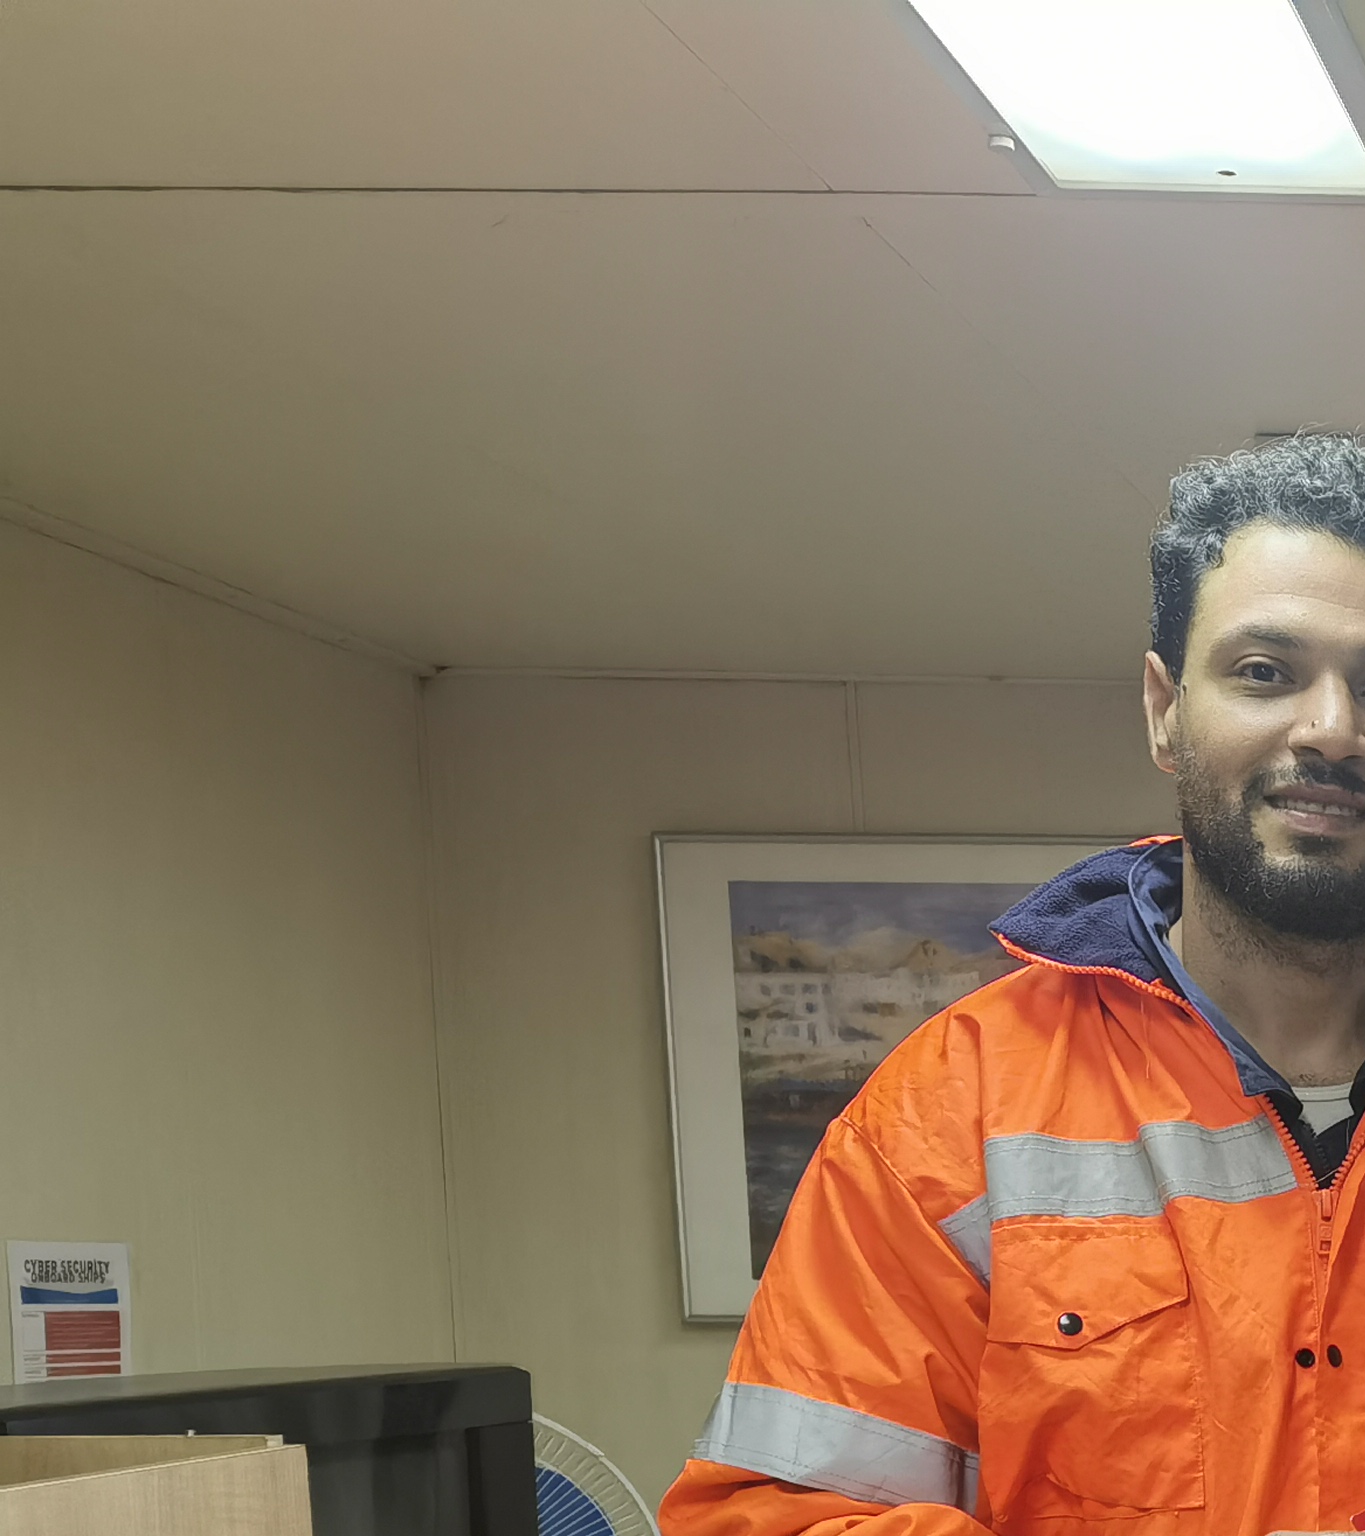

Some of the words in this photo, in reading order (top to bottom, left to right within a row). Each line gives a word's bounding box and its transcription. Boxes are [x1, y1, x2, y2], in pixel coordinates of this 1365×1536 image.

[24, 1259, 57, 1274] CYBER
[60, 1259, 110, 1275] SECURITY
[31, 1272, 75, 1284] ONBOARD
[77, 1272, 106, 1284] SHIPS
